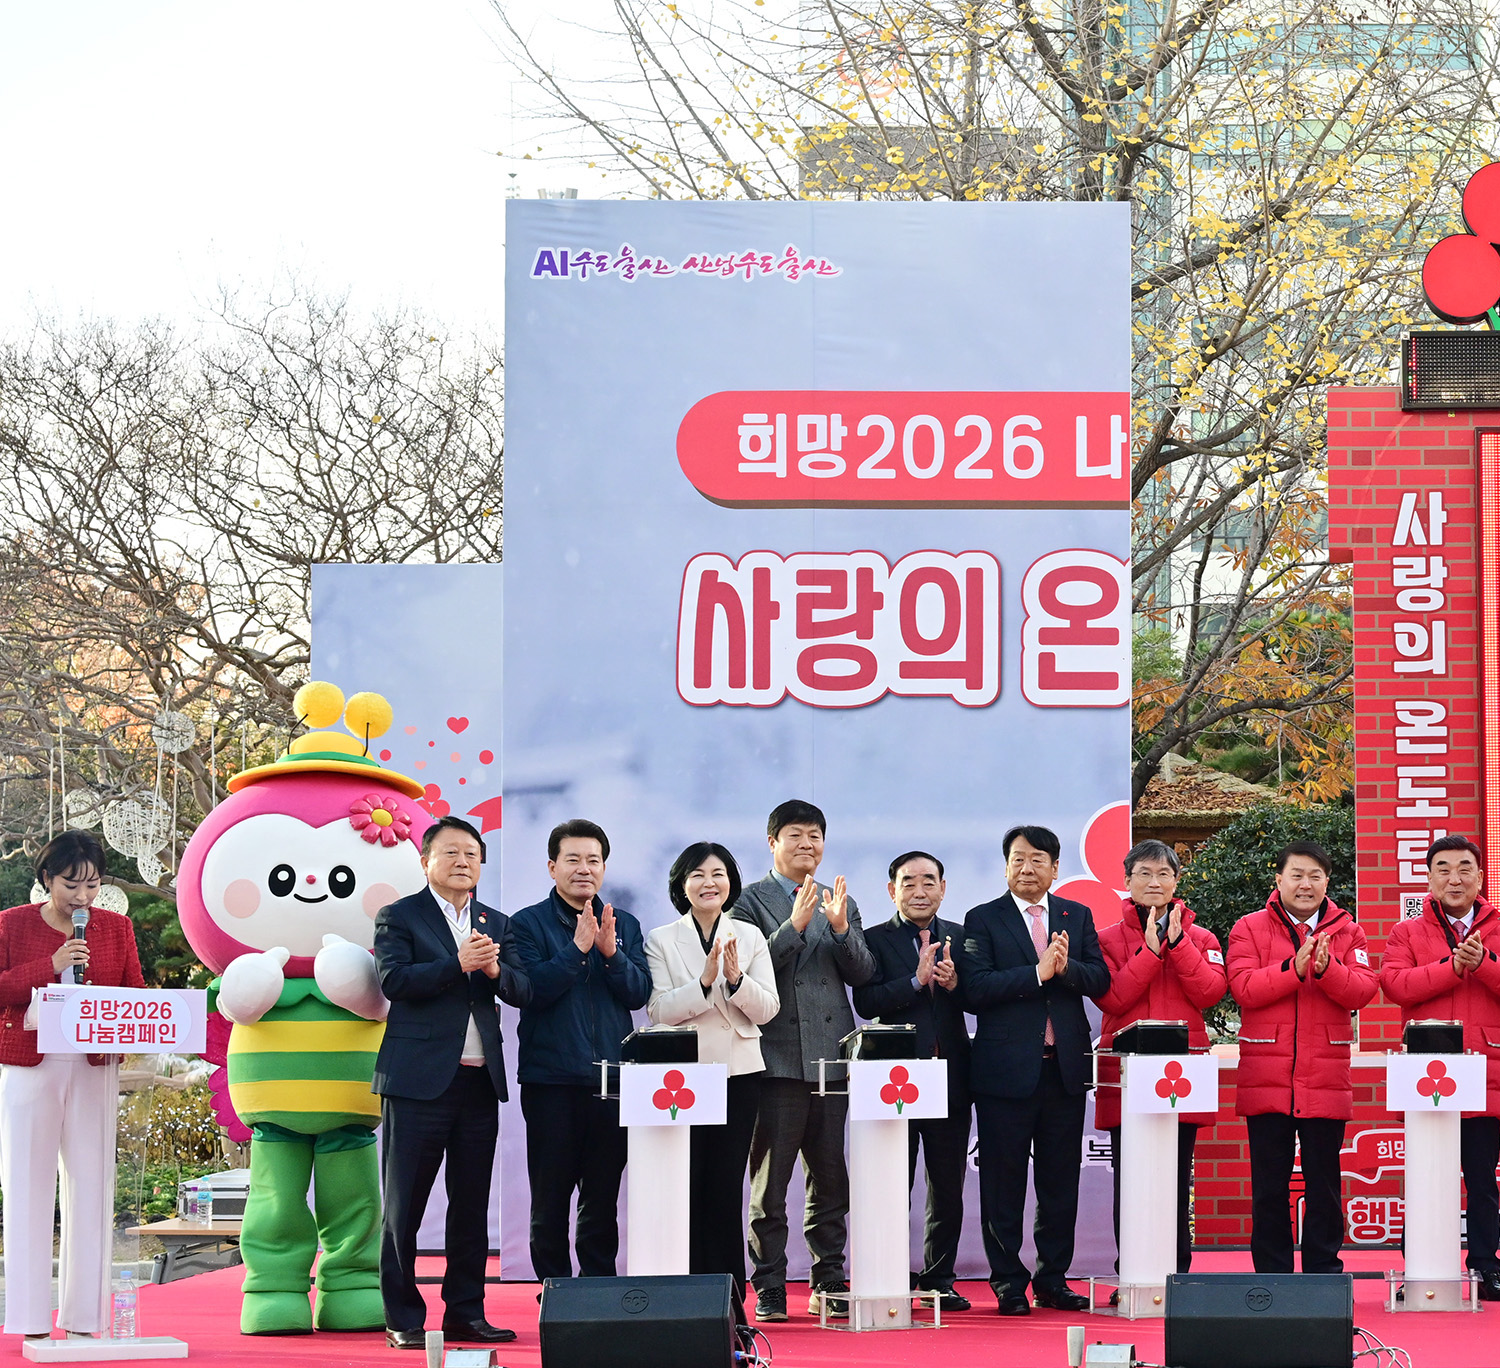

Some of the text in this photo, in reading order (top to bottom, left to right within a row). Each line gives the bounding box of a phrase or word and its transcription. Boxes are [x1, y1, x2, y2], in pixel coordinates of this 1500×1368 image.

[737, 412, 1045, 480] 희망2026
[1392, 490, 1448, 675] 사랑의
[691, 564, 1121, 692] 사랑의 온
[75, 1023, 177, 1045] 나눔캠페인
[79, 999, 173, 1022] 희망2026
